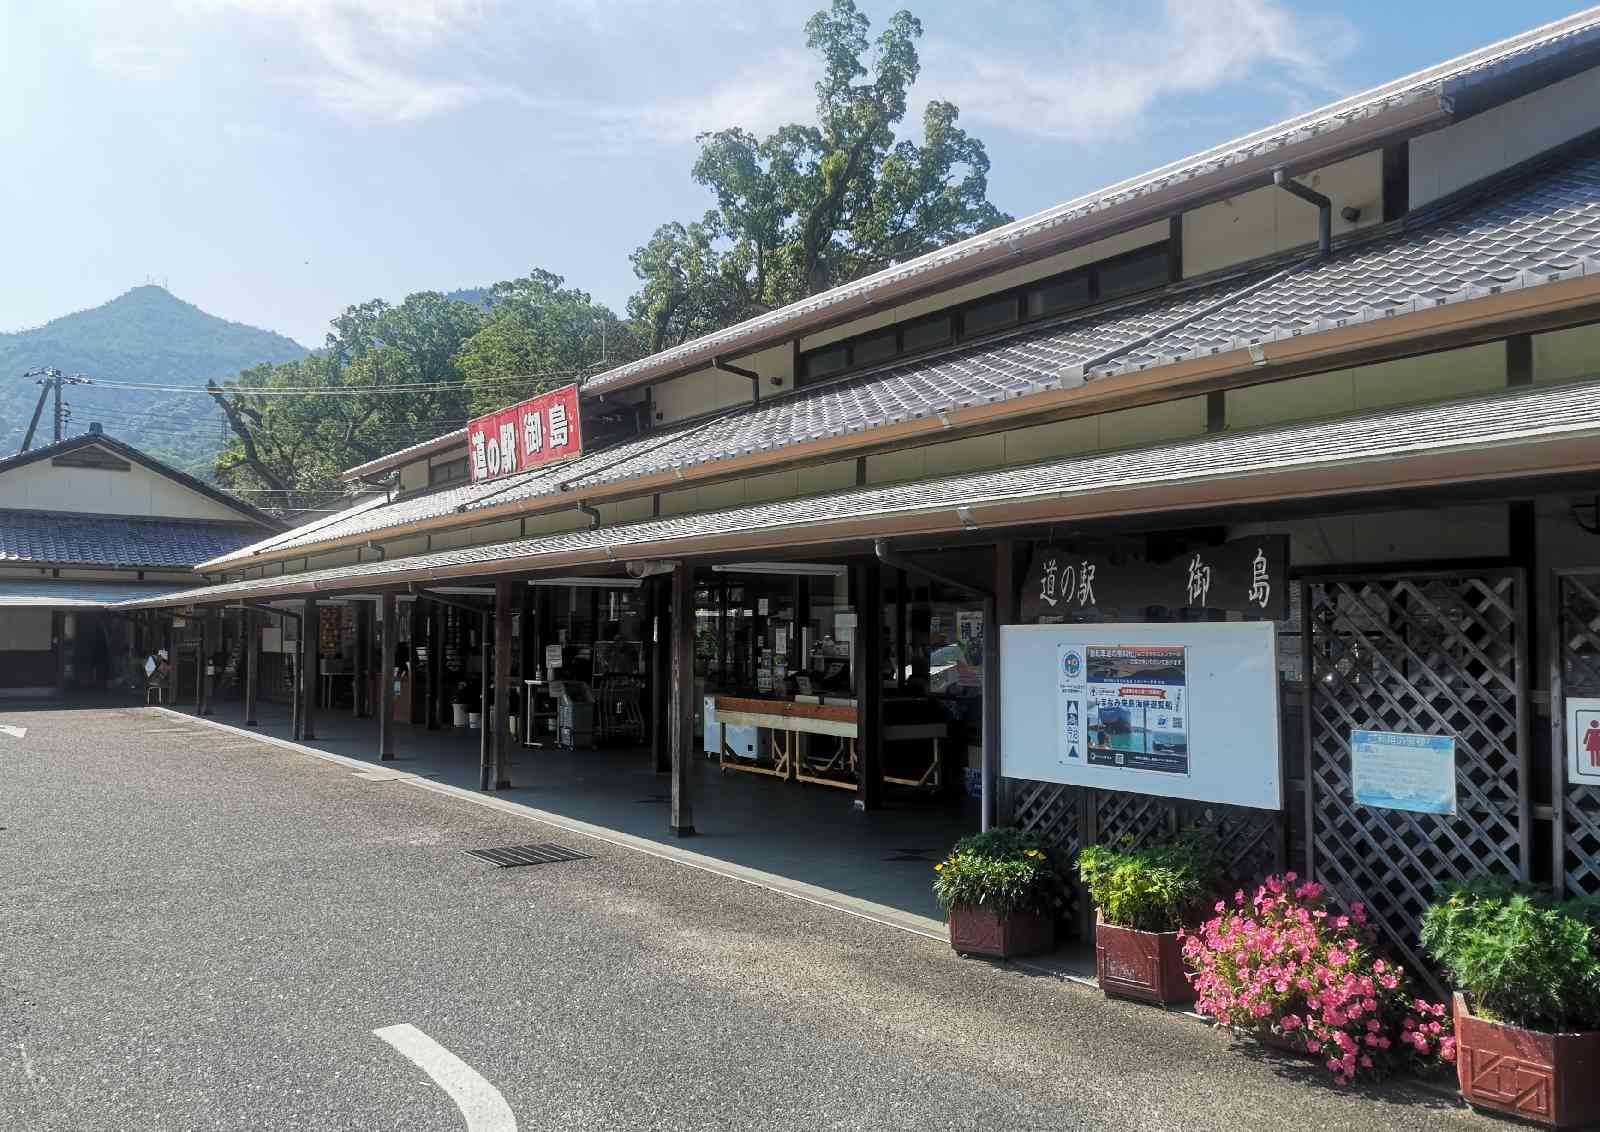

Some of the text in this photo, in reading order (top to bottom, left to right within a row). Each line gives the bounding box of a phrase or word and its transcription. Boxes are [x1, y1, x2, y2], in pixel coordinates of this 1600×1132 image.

[472, 404, 568, 481] 道の駅 御島
[1040, 560, 1096, 607] 道の駅
